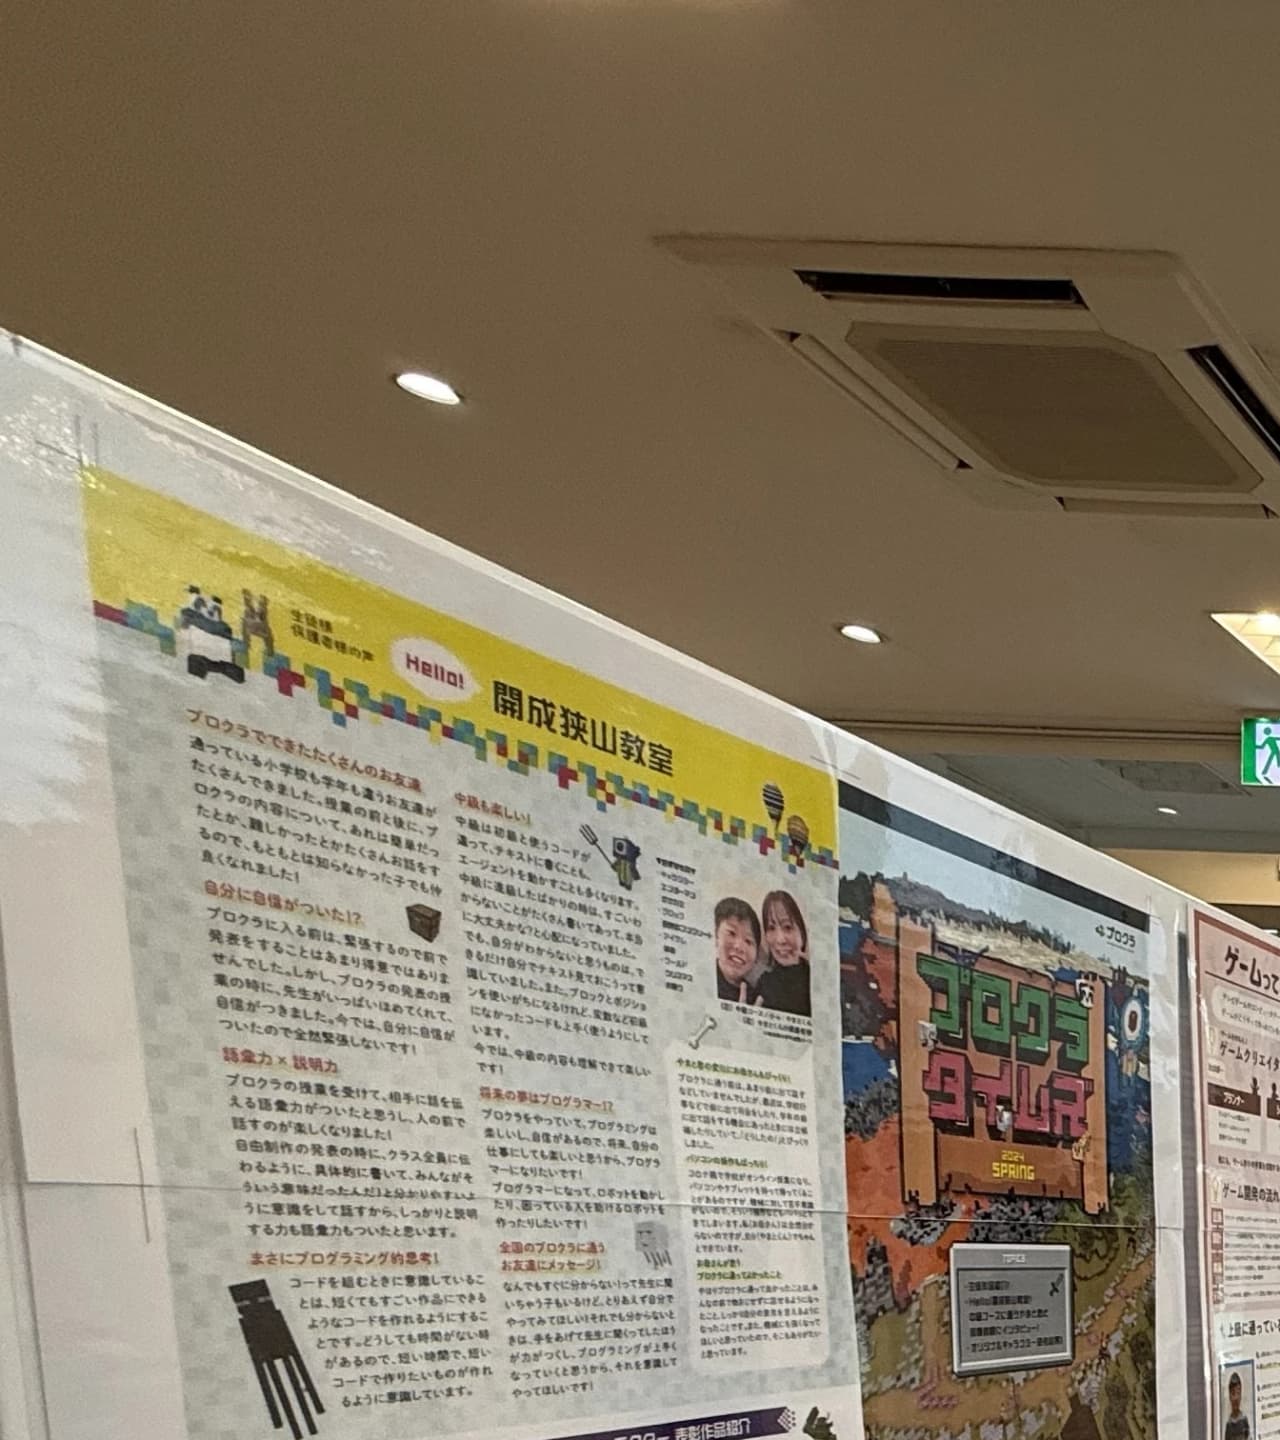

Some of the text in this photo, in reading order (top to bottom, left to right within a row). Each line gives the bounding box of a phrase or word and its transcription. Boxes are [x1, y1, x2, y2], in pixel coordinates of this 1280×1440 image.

[404, 651, 466, 692] Hello!
[187, 708, 423, 792] プロクラでできたたくさんのお友達
[492, 677, 676, 779] 開成狭山教室
[190, 735, 437, 818] 通っている小学校も学年も違うお友達が
[209, 928, 450, 985] 発表をすることはあまり得意ではありま
[1105, 925, 1136, 947] プロクラ
[991, 1162, 1036, 1180] SPRING
[1001, 1150, 1025, 1162] 2024
